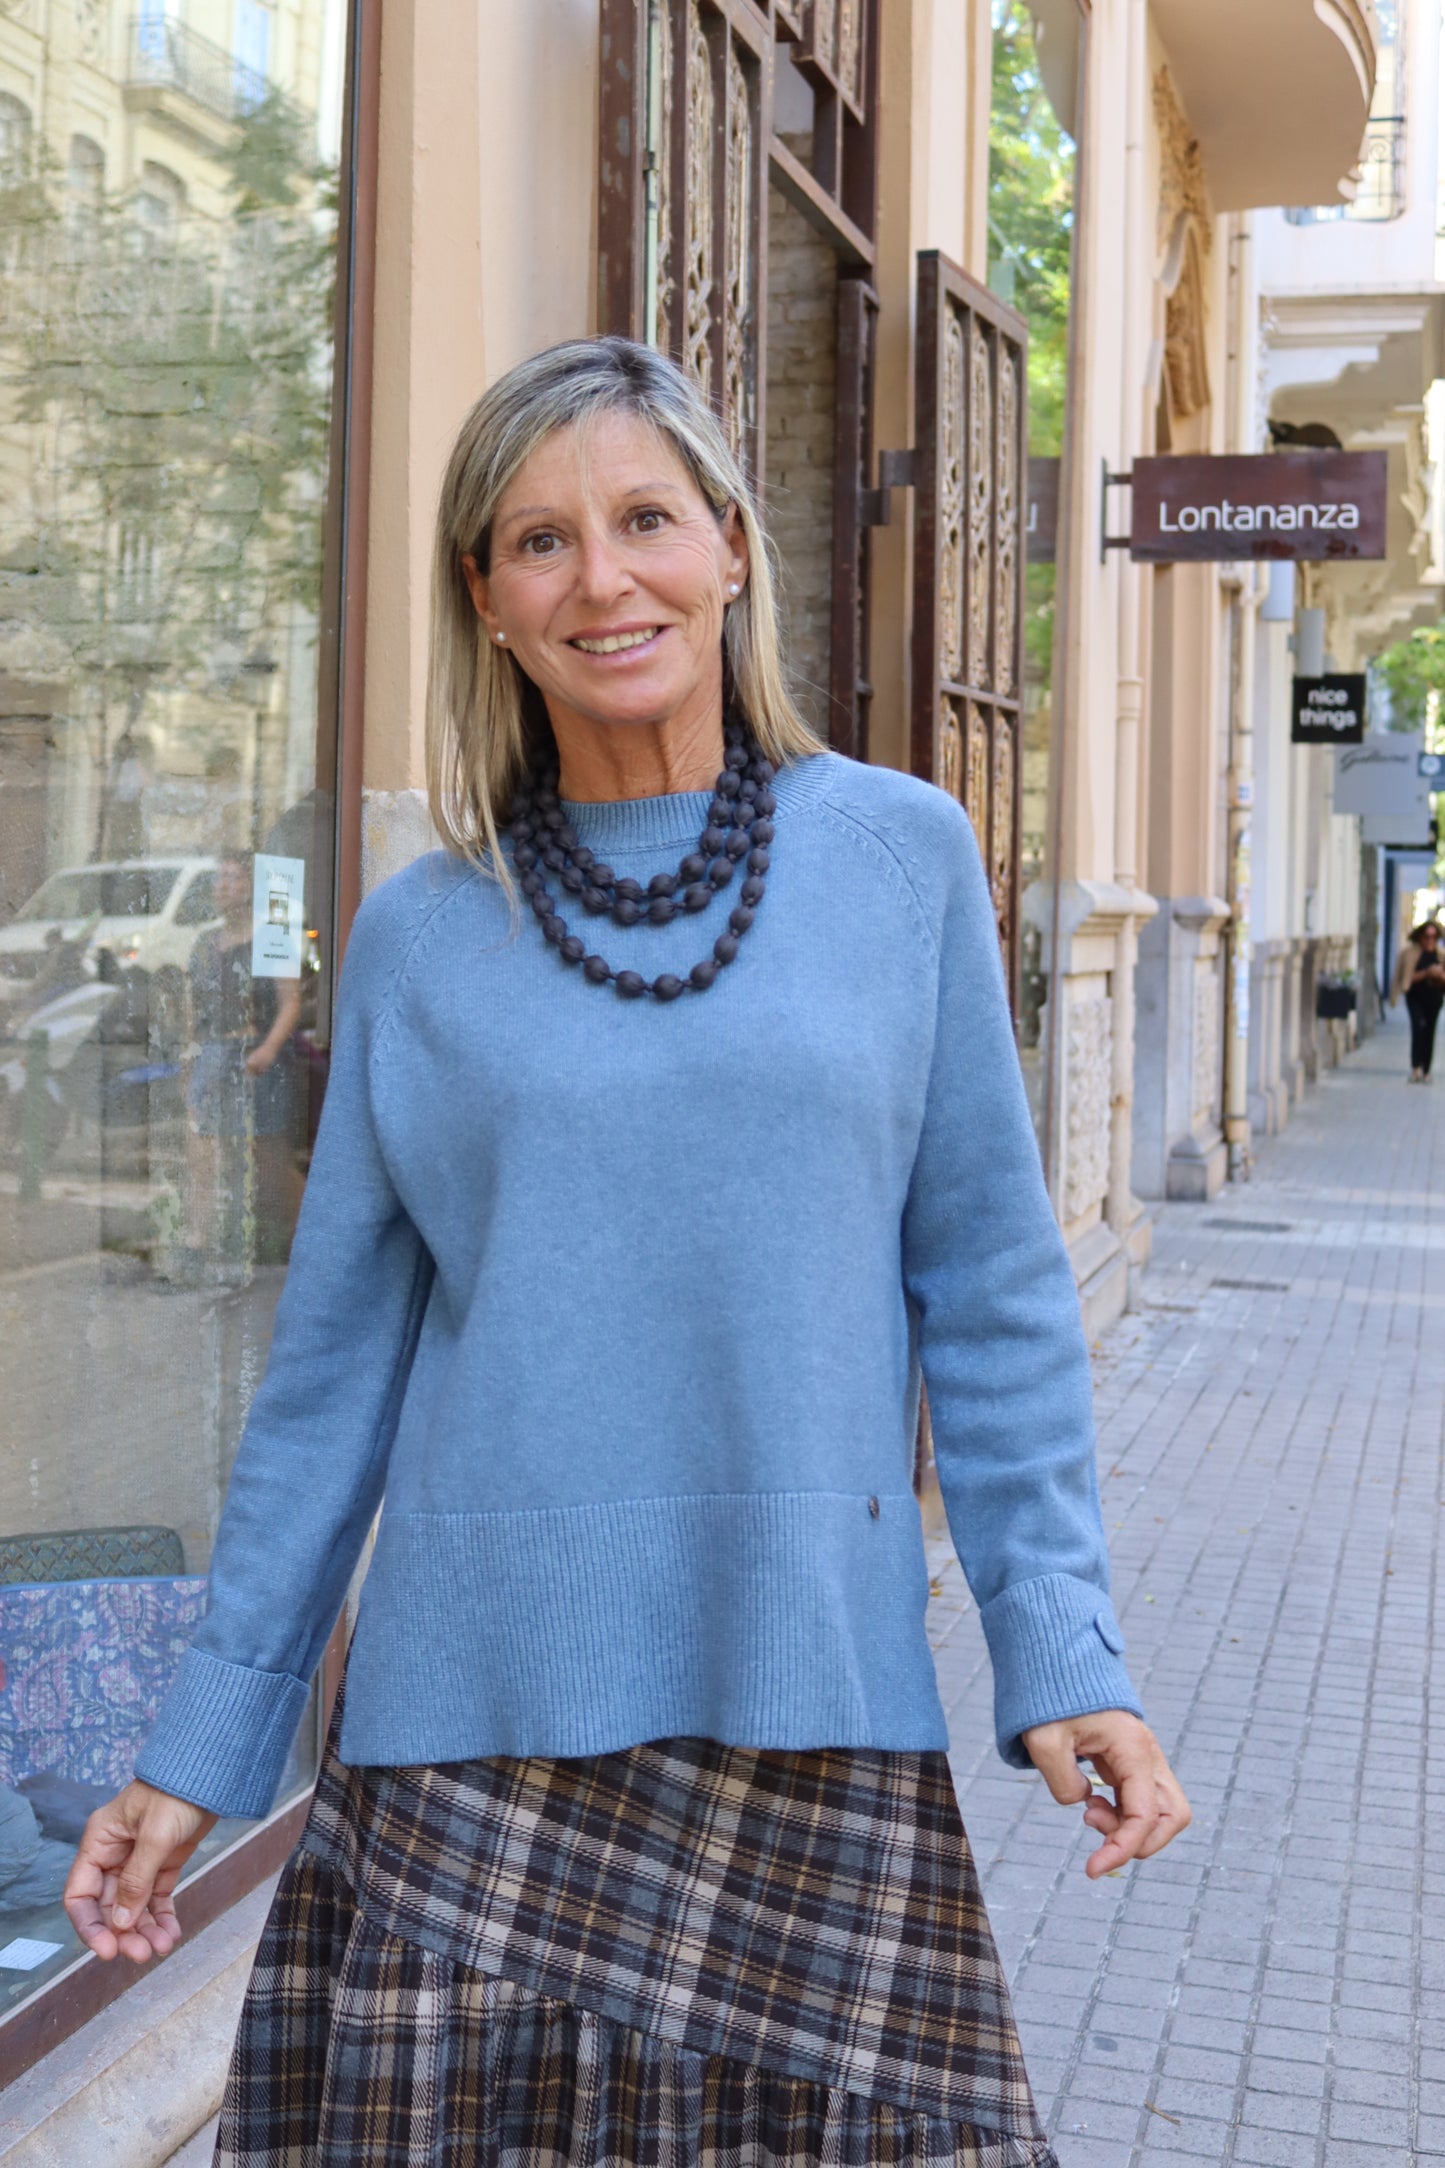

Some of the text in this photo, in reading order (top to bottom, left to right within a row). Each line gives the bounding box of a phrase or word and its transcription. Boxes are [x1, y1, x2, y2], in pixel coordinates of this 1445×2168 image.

[1159, 499, 1359, 533] Lontananza
[1307, 685, 1349, 706] nice
[1299, 707, 1358, 731] things
